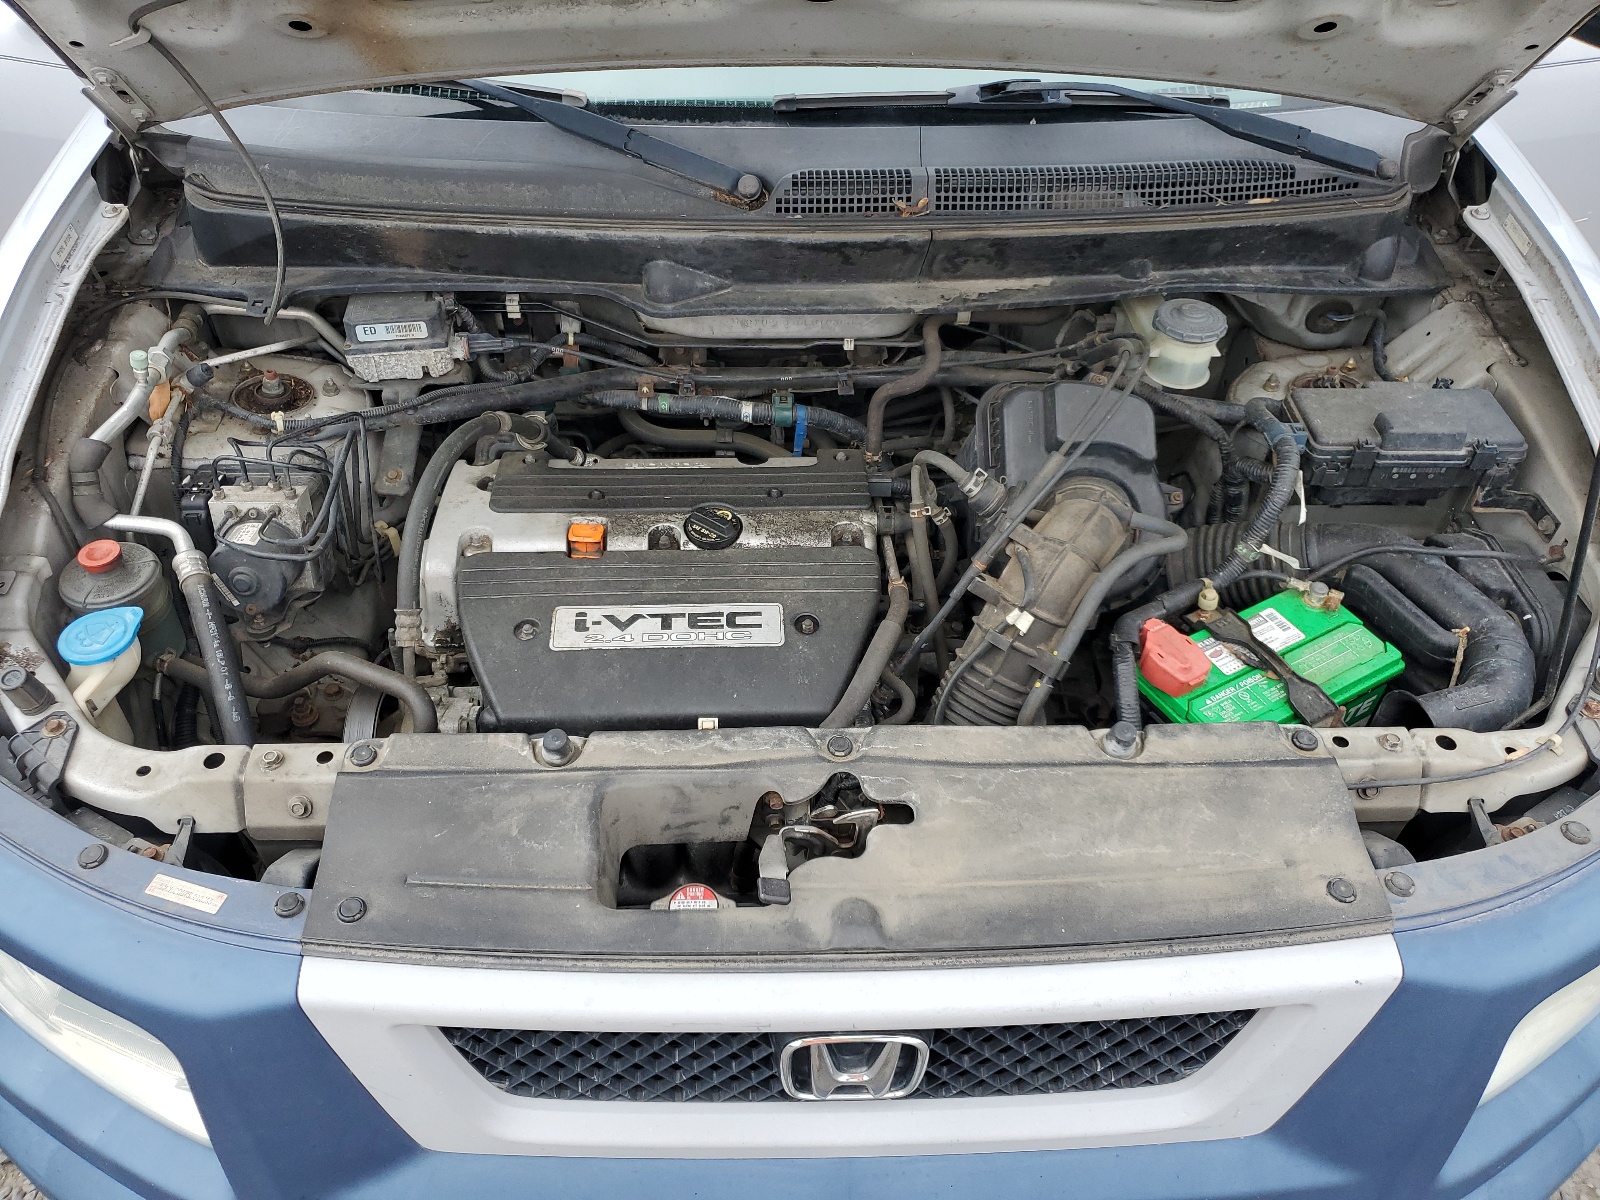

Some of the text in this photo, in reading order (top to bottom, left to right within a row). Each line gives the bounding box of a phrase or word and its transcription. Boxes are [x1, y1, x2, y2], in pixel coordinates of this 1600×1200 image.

[363, 326, 377, 336] ED
[574, 611, 763, 632] i-VTEC
[584, 631, 753, 644] 2.4 DOHC
[1210, 686, 1236, 702] DANGER
[1239, 673, 1263, 688] POISON
